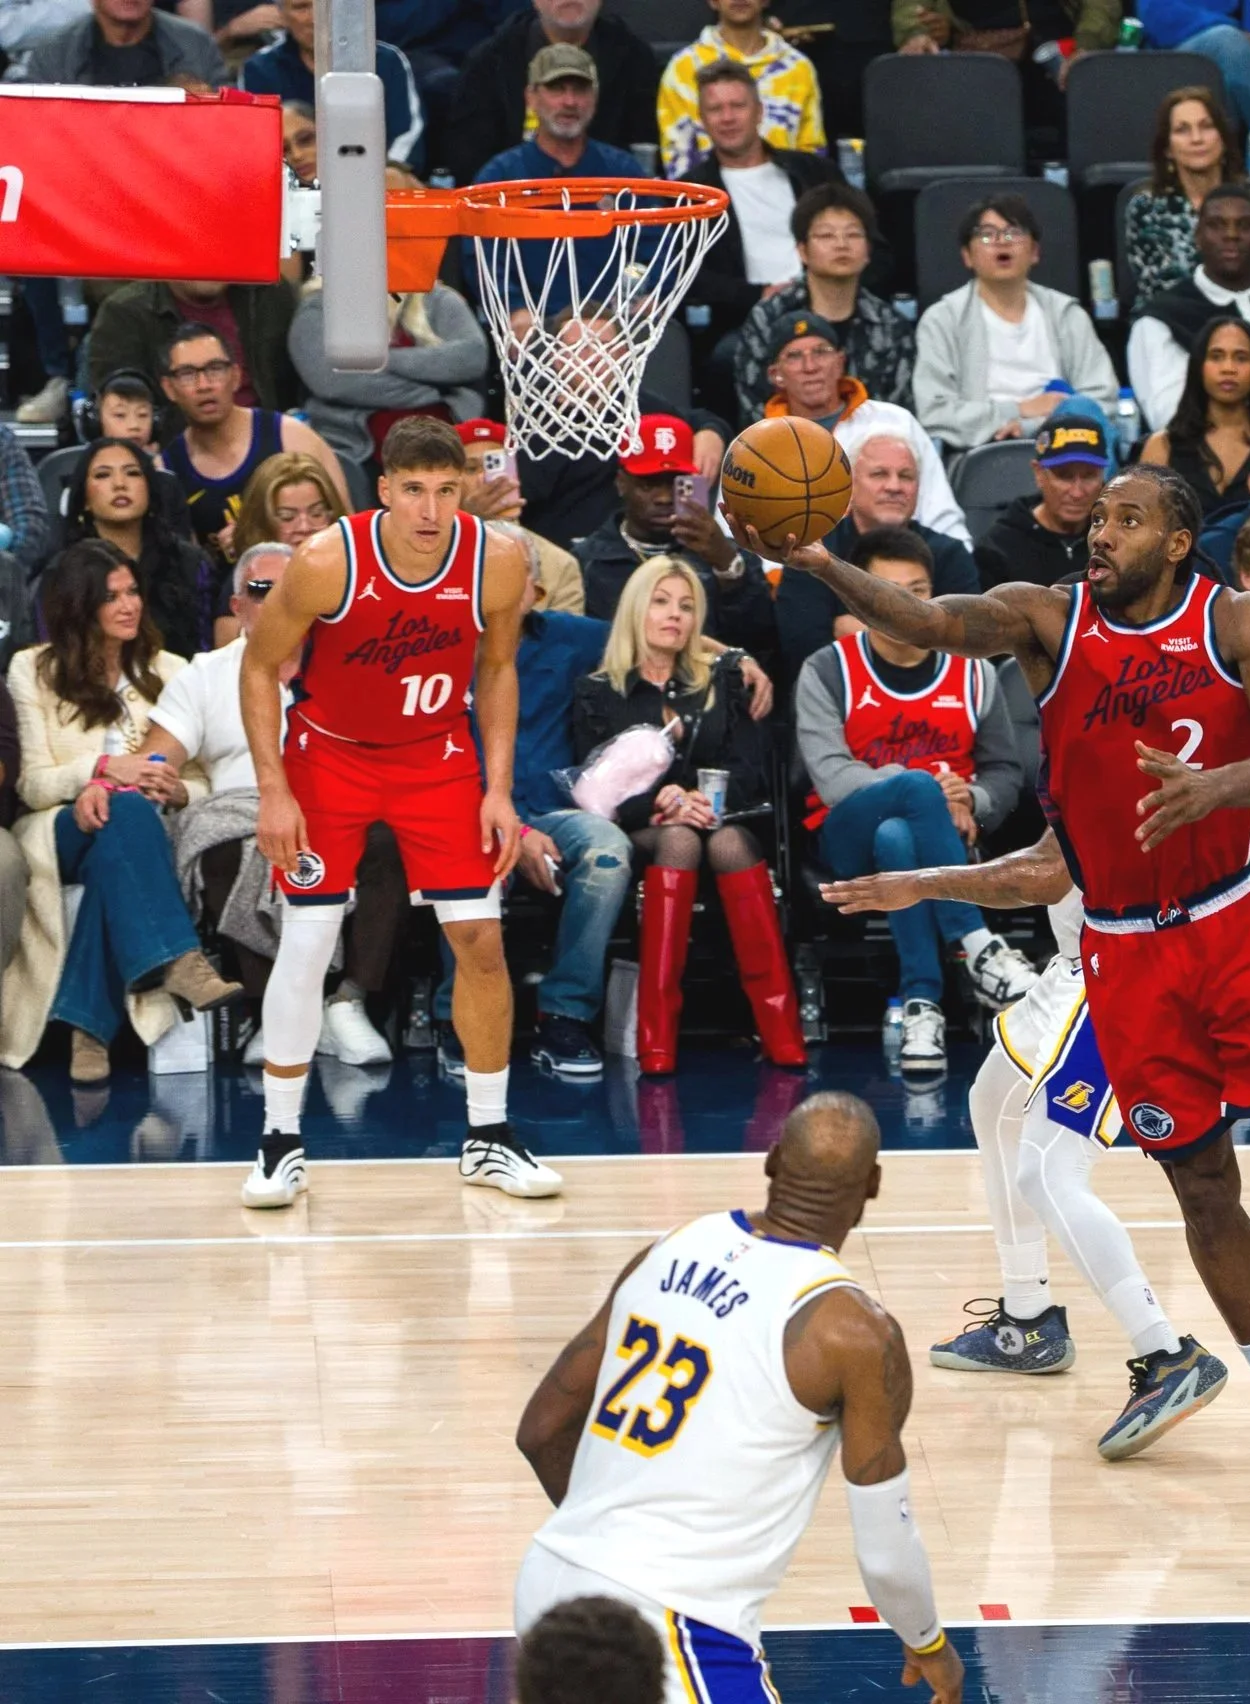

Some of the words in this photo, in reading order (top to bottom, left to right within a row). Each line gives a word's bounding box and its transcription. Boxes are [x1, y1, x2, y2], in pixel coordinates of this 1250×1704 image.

[381, 609, 431, 641] Los
[1168, 637, 1192, 645] VISIT
[343, 624, 463, 675] Angeles
[1160, 642, 1199, 653] RWANDA
[1115, 655, 1172, 688] Los
[400, 673, 453, 716] 10
[1083, 661, 1216, 732] Angeles
[888, 711, 931, 745] Los
[1171, 718, 1204, 770] 2
[660, 1258, 750, 1319] JAMES
[589, 1313, 714, 1459] 23
